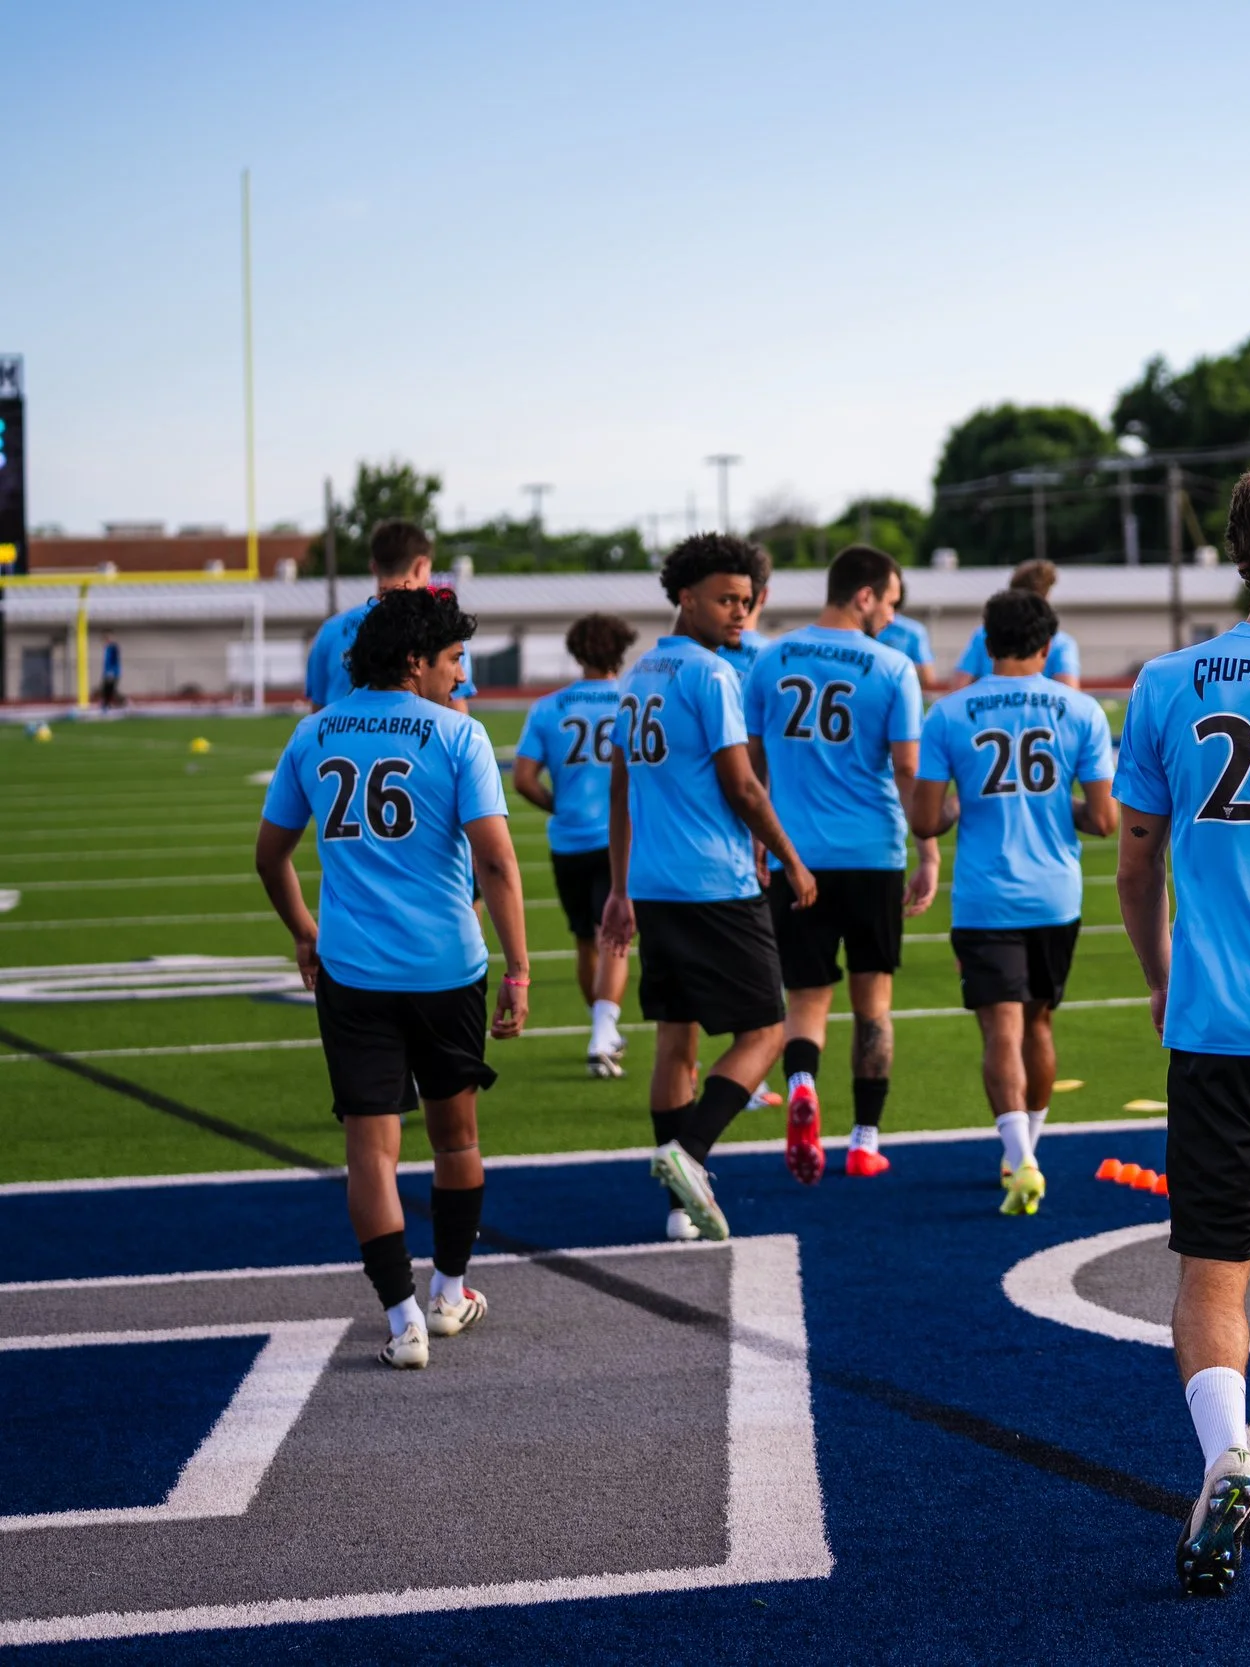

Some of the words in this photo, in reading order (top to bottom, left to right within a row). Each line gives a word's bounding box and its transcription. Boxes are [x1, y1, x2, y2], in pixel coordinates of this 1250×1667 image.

[780, 642, 875, 677] CHUPACABRAS
[318, 716, 434, 749] CHUPACABRAS
[620, 694, 668, 767] 26
[777, 675, 856, 744] 26
[966, 692, 1067, 724] CHUPACABRAS
[971, 727, 1058, 797] 26
[316, 756, 417, 842] 26
